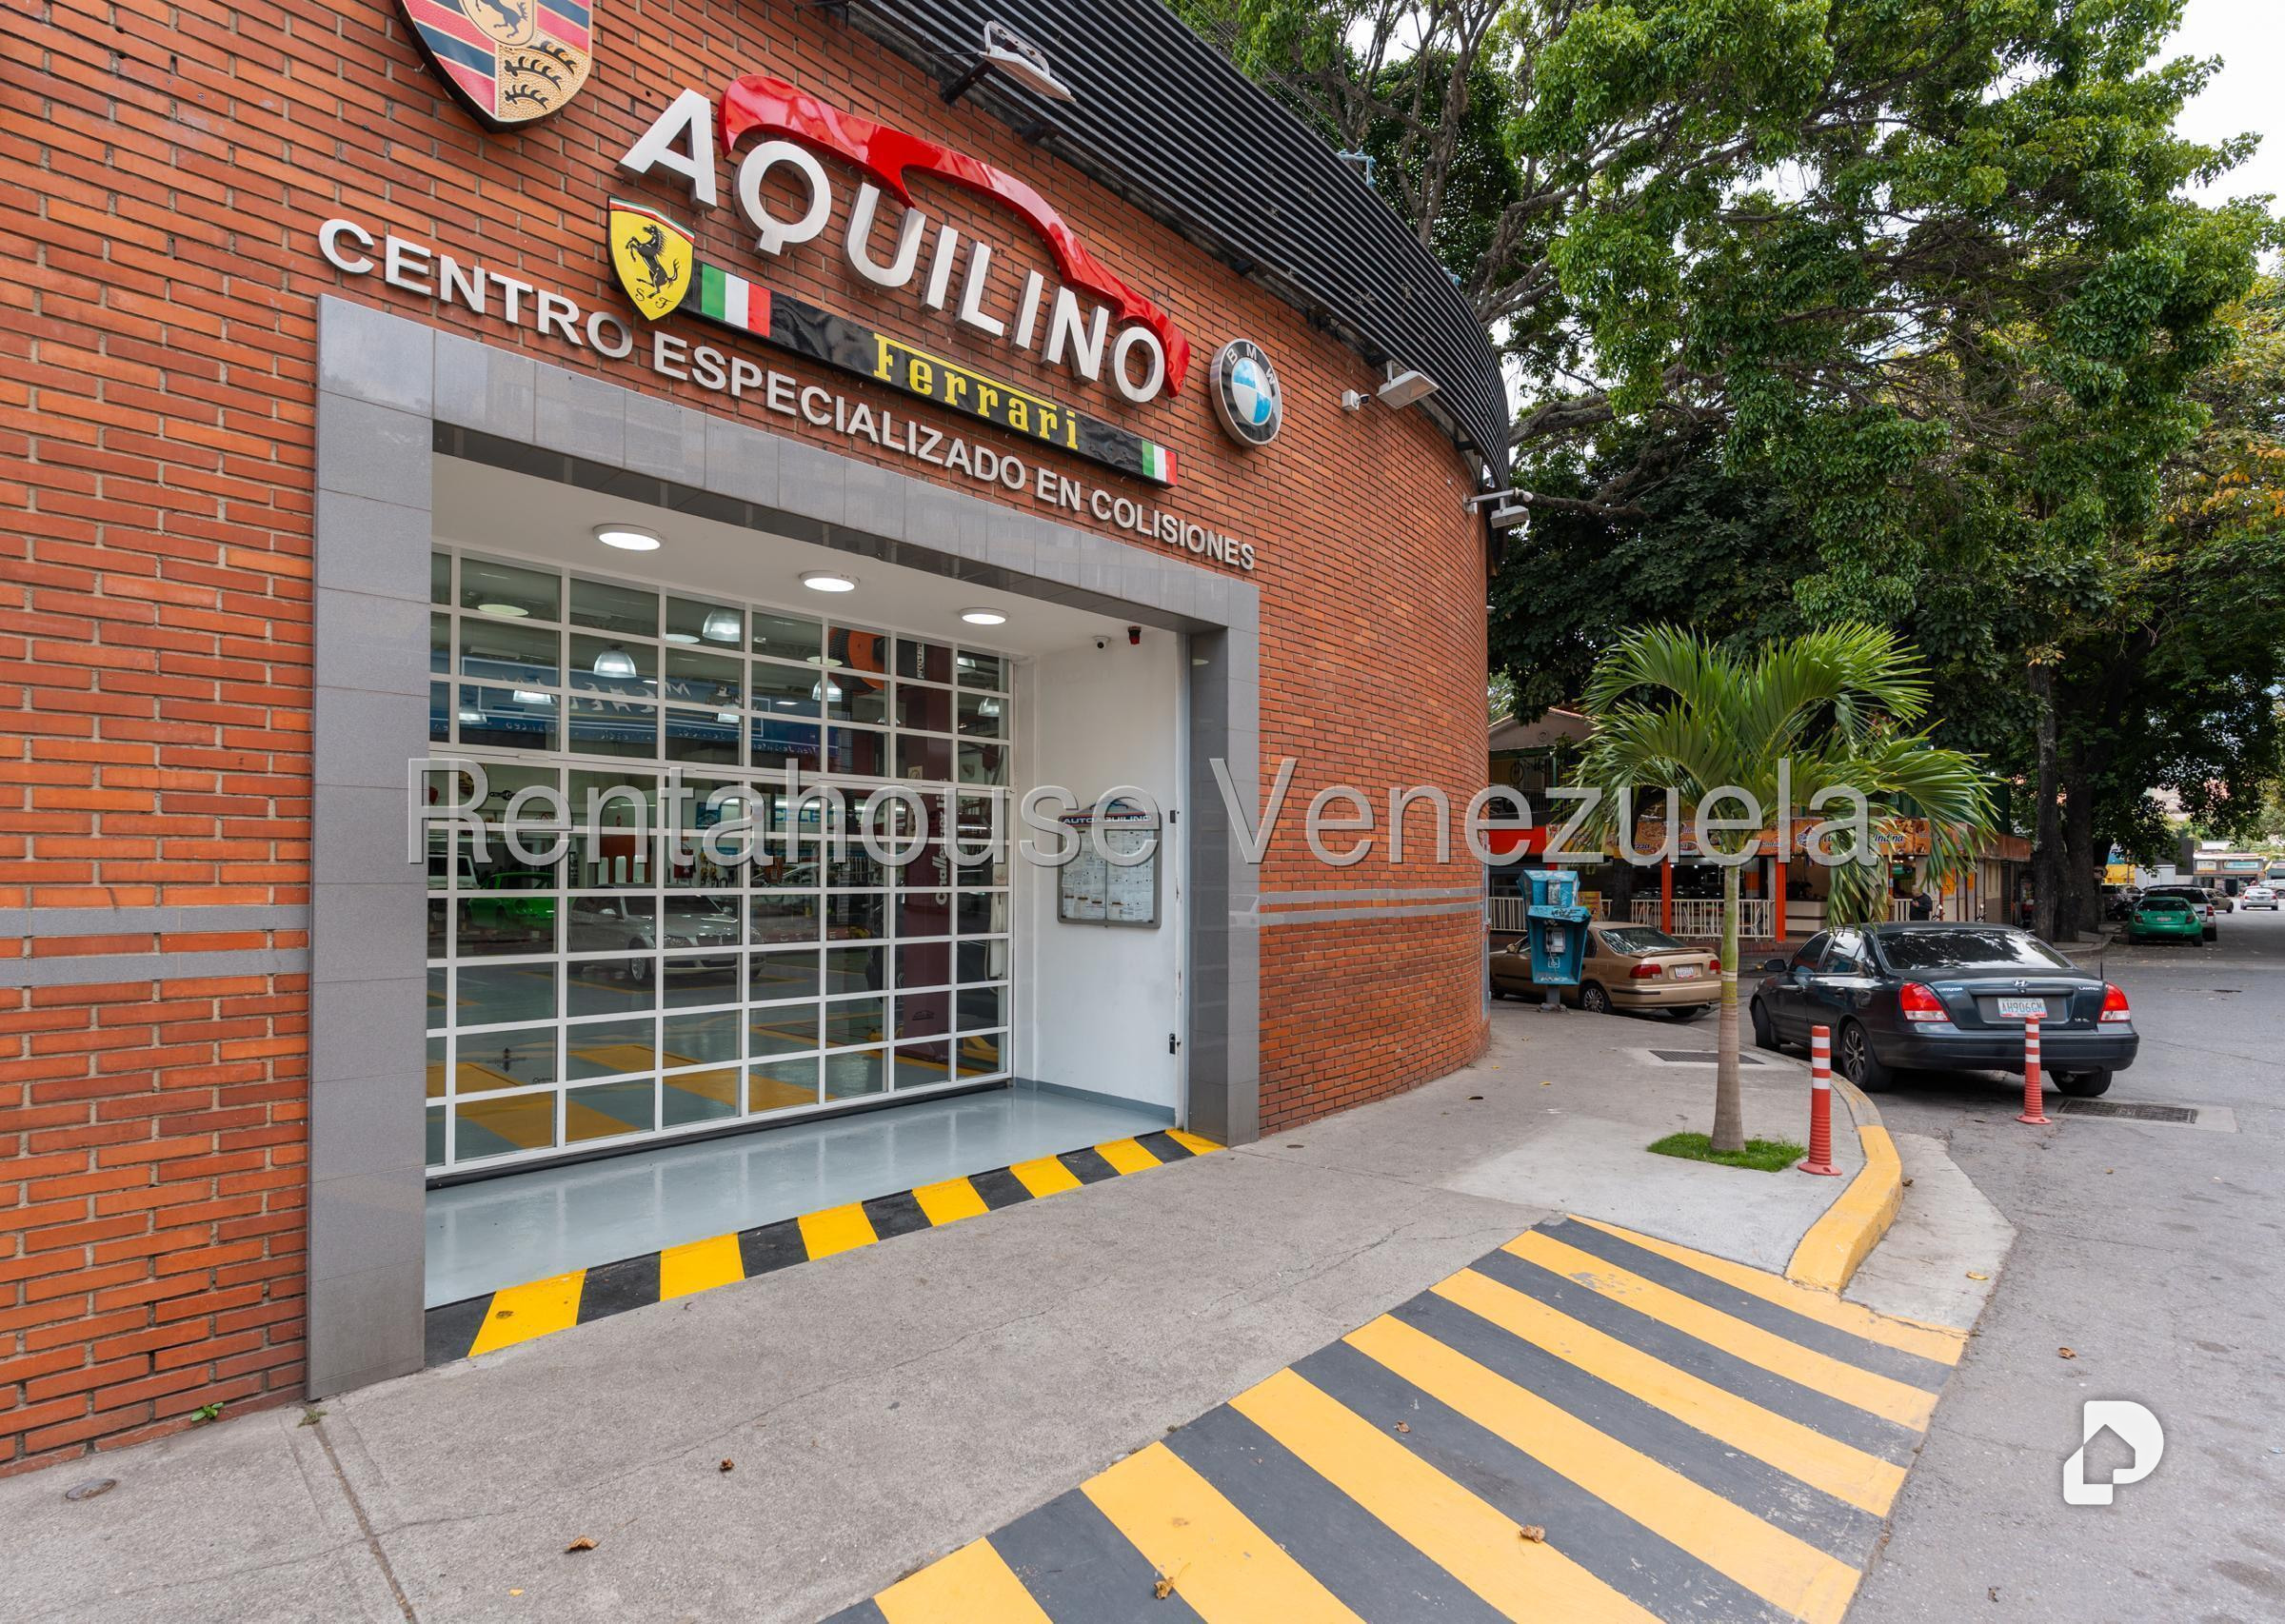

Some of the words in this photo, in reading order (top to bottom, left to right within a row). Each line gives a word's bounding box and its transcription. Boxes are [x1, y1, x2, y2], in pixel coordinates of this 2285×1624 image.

[617, 88, 1166, 404] AQUILINO
[318, 218, 632, 360] CENTRO
[654, 331, 1027, 490] ESPECIALIZADO
[1036, 467, 1081, 512] EN
[1091, 488, 1256, 570] COLISIONES
[872, 332, 1079, 451] Ferrari
[1226, 344, 1275, 386] BMW
[2001, 1001, 2043, 1013] AH906GM
